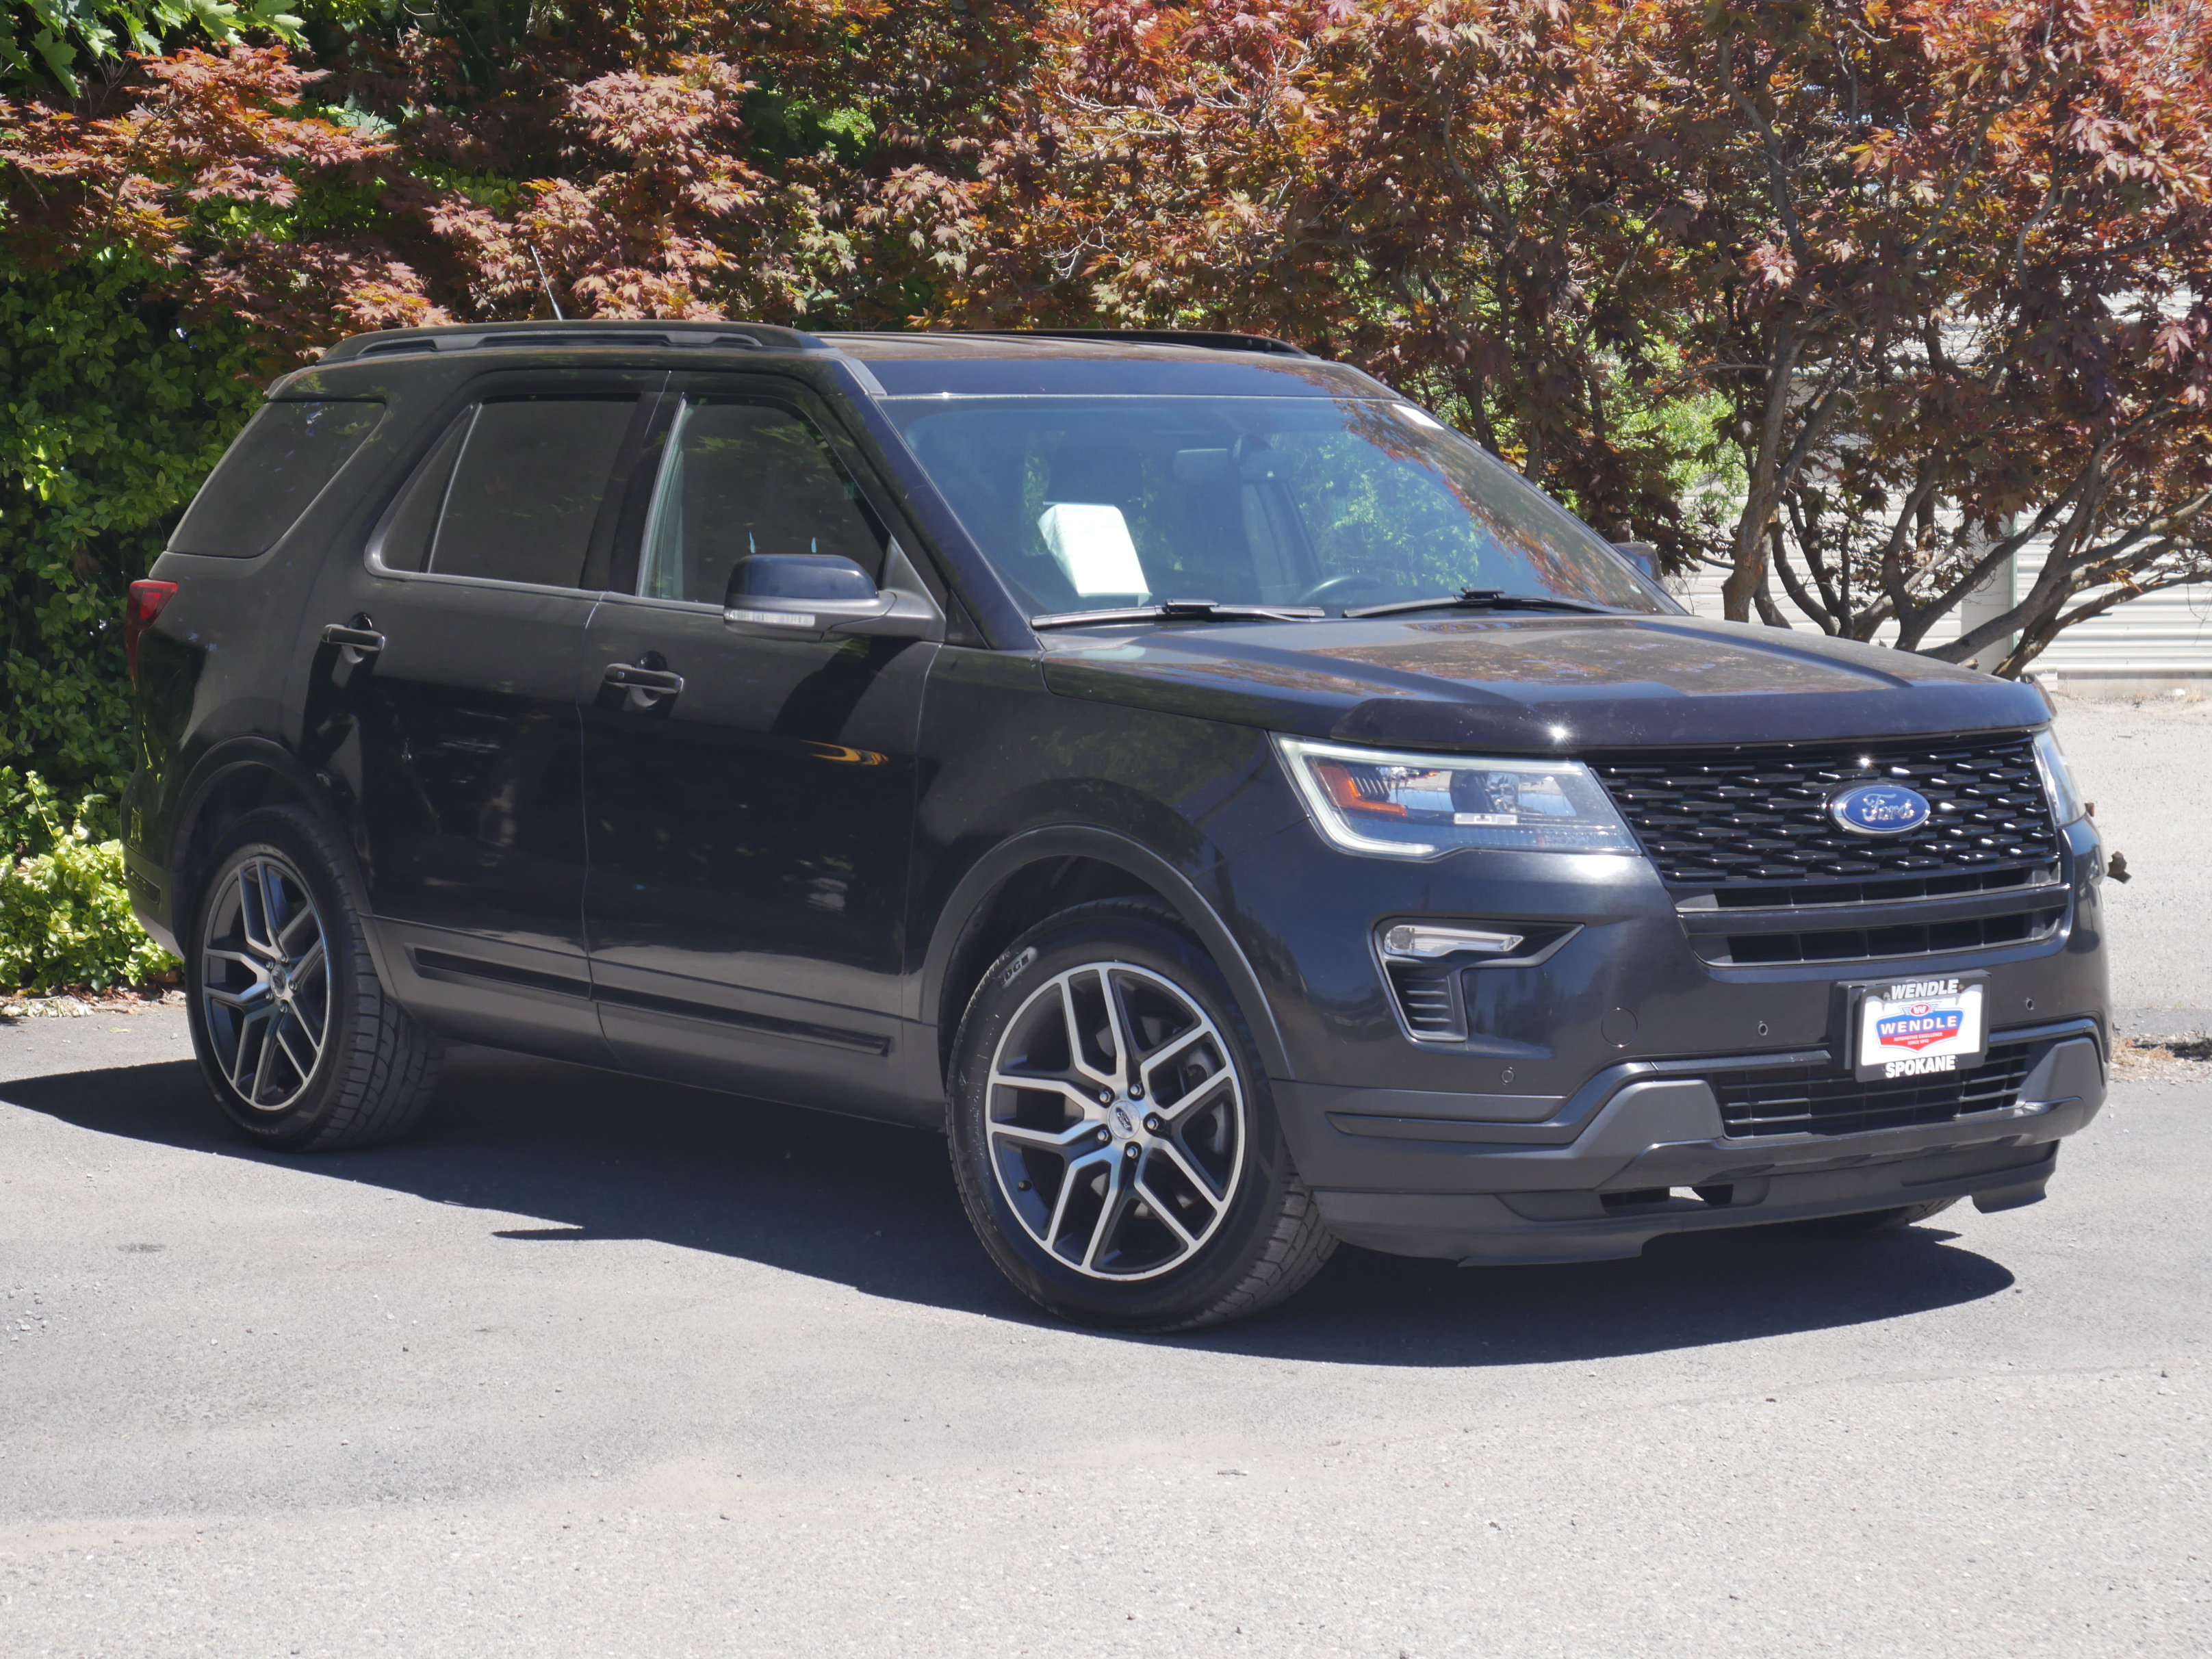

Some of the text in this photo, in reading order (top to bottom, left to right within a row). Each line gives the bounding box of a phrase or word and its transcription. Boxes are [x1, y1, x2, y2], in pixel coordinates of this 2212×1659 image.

[1862, 793, 1915, 822] Ford
[1891, 979, 1959, 1000] WENDLE
[1880, 1016, 1957, 1035] WENDLE
[1885, 1054, 1956, 1079] SPOKANE
[1117, 1109, 1131, 1129] Ford
